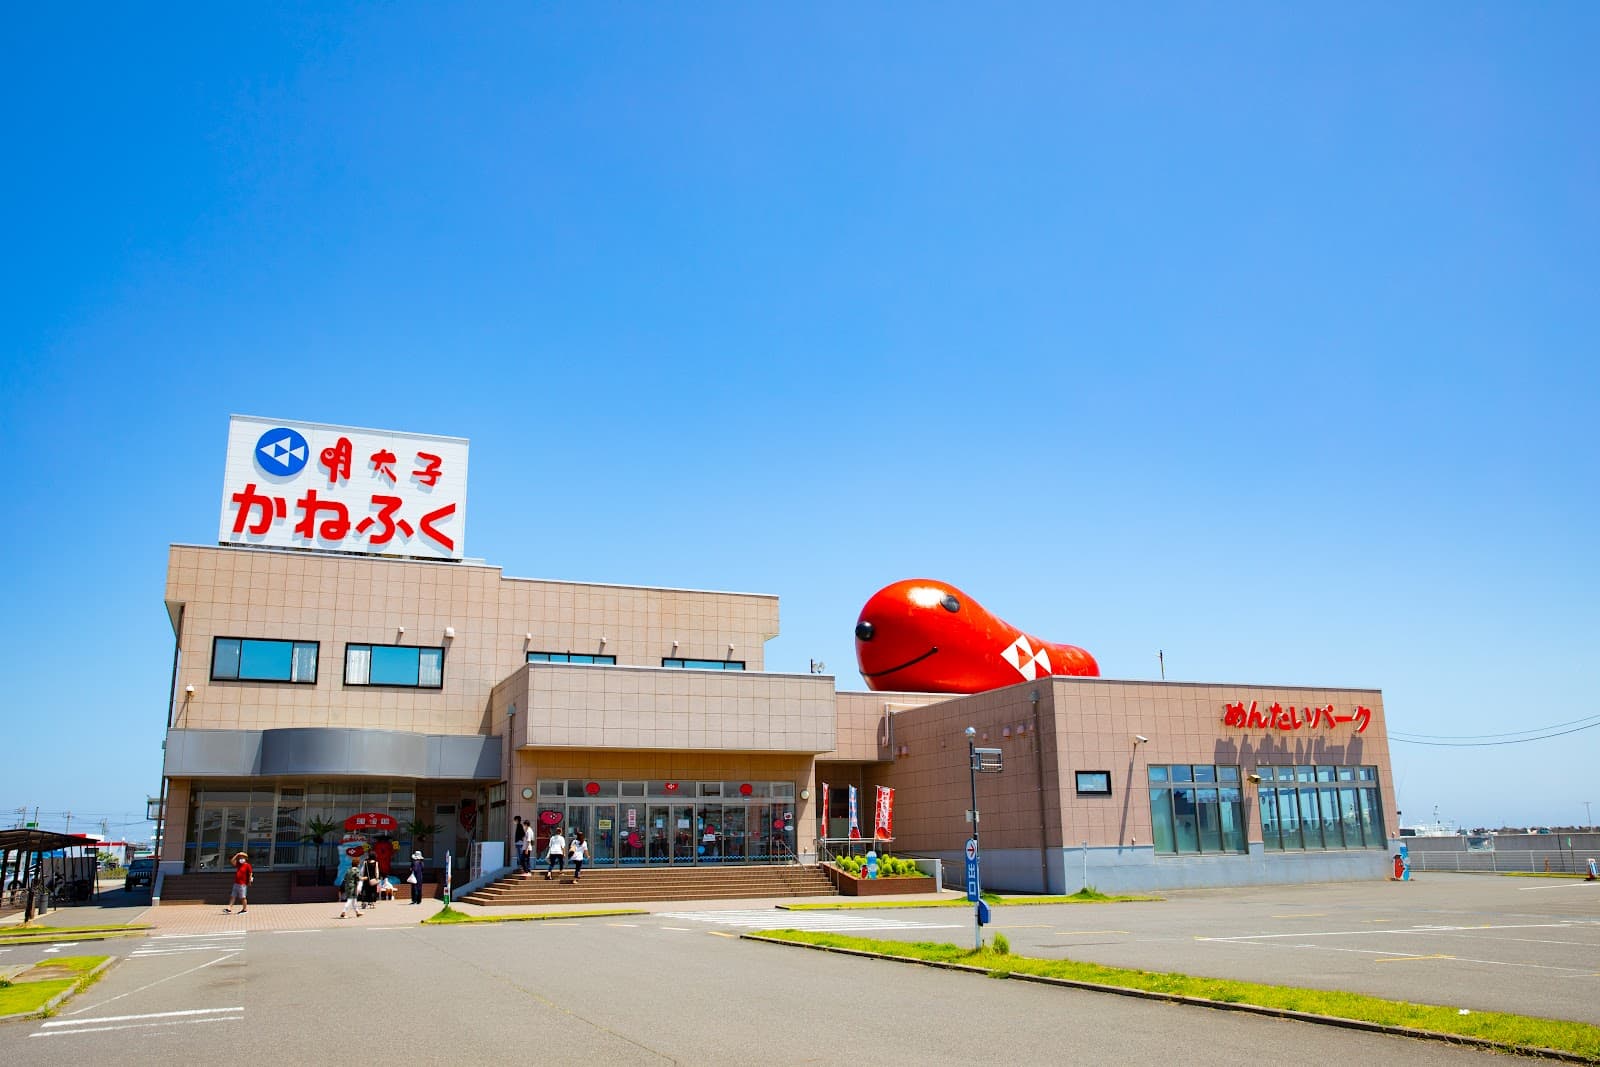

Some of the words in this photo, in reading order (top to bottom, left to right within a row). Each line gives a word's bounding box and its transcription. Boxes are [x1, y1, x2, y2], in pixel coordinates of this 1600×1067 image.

[319, 437, 442, 487] 明太子
[232, 483, 456, 550] かねふく
[1224, 700, 1371, 735] めんたいパーク
[968, 863, 977, 895] 出口
